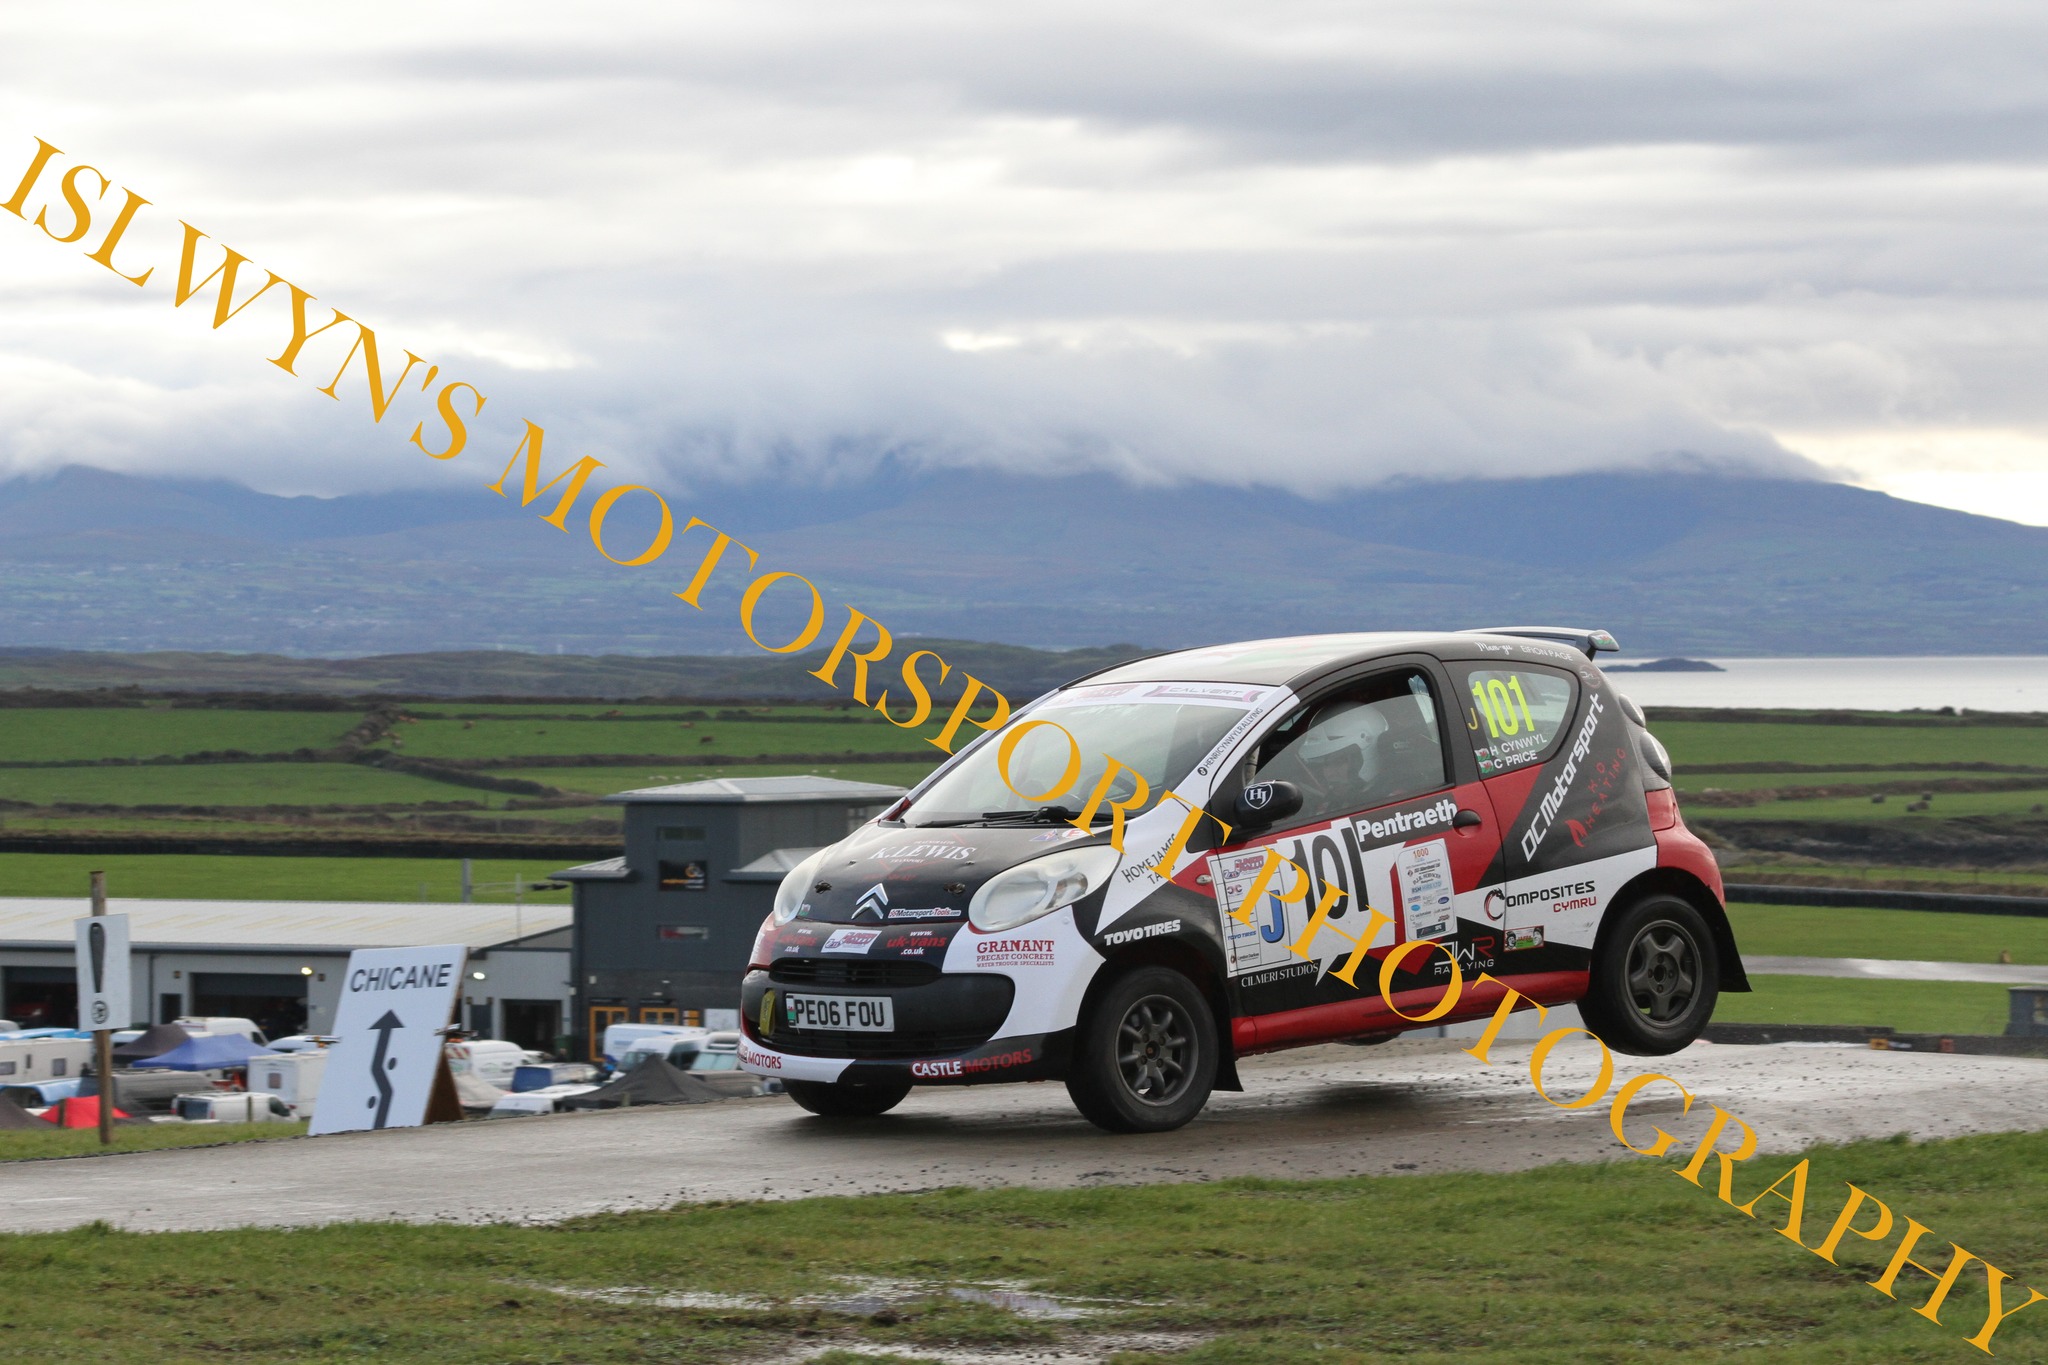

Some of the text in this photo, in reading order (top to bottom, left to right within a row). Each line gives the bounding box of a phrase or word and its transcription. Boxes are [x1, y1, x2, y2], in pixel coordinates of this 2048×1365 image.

[1168, 687, 1244, 696] CALVERT
[1472, 675, 1535, 738] 101
[1467, 707, 1478, 730] J
[1489, 733, 1548, 756] H CYNWYL
[1493, 750, 1538, 769] C PRICE
[1249, 787, 1268, 805] HJ
[1355, 799, 1458, 843] Pentraeth
[1413, 847, 1430, 859] 1000
[1121, 857, 1153, 884] HOME
[1289, 827, 1370, 924] 101
[1553, 896, 1597, 913] CYMRU
[1261, 889, 1285, 944] J
[886, 936, 947, 949] uk-vans
[1104, 920, 1181, 946] TOYO TIRES
[900, 947, 925, 956] .co.uk
[976, 939, 1055, 954] GRANANT
[976, 953, 1010, 962] PRECAST
[350, 963, 453, 993] CHICANE
[1241, 962, 1319, 988] CILMERI STUDIOS
[1434, 959, 1495, 976] RALYING
[794, 999, 841, 1026] PE06
[845, 1001, 886, 1027] FOU
[748, 1051, 782, 1070] MOTORS
[911, 1048, 1033, 1077] CASTLE MOTORS
